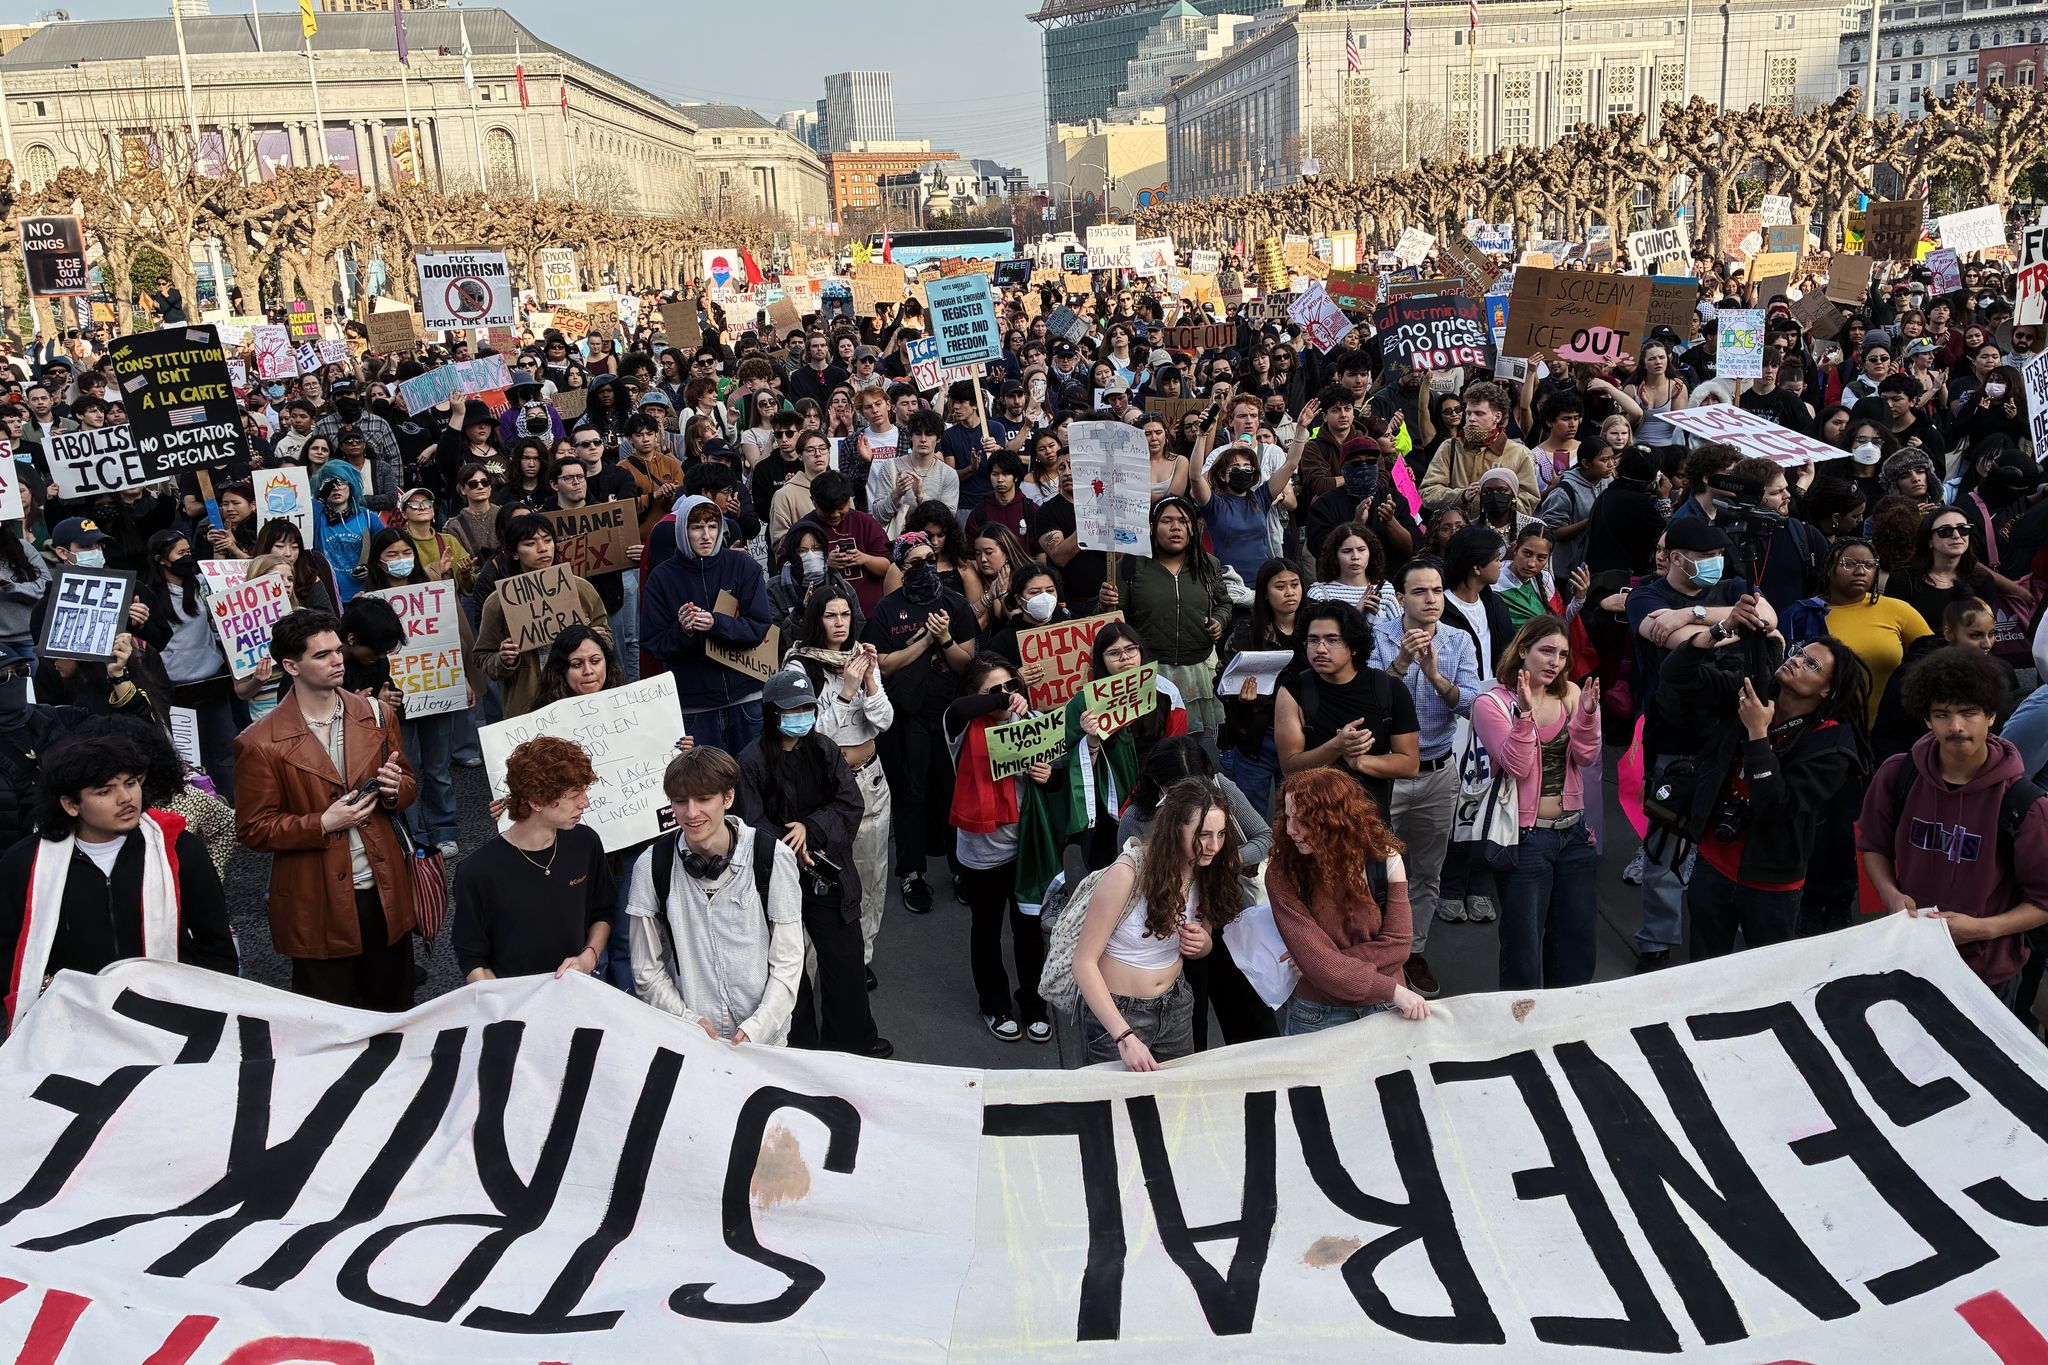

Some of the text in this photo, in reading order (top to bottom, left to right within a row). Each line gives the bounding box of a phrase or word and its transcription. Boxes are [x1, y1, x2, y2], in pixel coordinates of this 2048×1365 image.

[28, 222, 54, 237] NO
[24, 239, 65, 251] KINGS
[1475, 239, 1511, 251] DIVERSITY
[1635, 230, 1682, 257] CHINGA
[56, 258, 81, 270] ICE
[59, 268, 80, 278] OUT
[423, 263, 505, 278] DOOMERISM
[547, 263, 572, 274] NEEDS
[725, 296, 738, 304] NO
[740, 294, 754, 303] ONE
[934, 292, 987, 309] ENOUGH IS ENOUGH!
[1537, 276, 1635, 306] I SCREAM
[1651, 286, 1683, 300] eople
[293, 301, 306, 312] NO
[941, 303, 984, 322] REGISTER
[1550, 302, 1596, 318] for
[1651, 300, 1678, 310] over
[290, 312, 316, 324] SECRET
[426, 319, 457, 328] FIGHT
[461, 317, 481, 326] LIKE
[727, 321, 758, 333] STOLEN
[1379, 306, 1399, 331] all
[1403, 303, 1457, 322] vermin
[1397, 316, 1478, 338] no mice
[1649, 312, 1689, 325] rofits!
[291, 324, 318, 337] POLICE
[378, 332, 410, 342] GESTAPO
[942, 320, 989, 339] PEACE AND
[1165, 325, 1236, 350] ICE OUT
[1526, 323, 1630, 358] ICE OUT
[1719, 329, 1758, 349] ICE
[112, 344, 134, 362] THE
[907, 338, 938, 365] ICE
[946, 335, 988, 353] FREEDOM
[1399, 331, 1476, 358] no lice
[116, 348, 223, 374] CONSTITUTION
[1412, 350, 1450, 371] NO
[1451, 349, 1487, 367] ICE
[156, 368, 190, 385] ISN'T
[159, 391, 178, 406] LA
[180, 384, 229, 403] CARTE
[140, 422, 239, 454] NO DICTATOR
[1708, 429, 1841, 462] ICE
[156, 441, 236, 471] SPECIALS
[68, 450, 146, 493] ICE
[60, 578, 124, 609] ICE
[501, 566, 571, 606] CHINGA
[225, 580, 274, 616] HOT
[388, 586, 446, 619] ON'T
[221, 600, 284, 640] PEOPLE
[531, 601, 554, 620] LA
[49, 607, 120, 656] OUT
[407, 616, 440, 639] KE
[518, 608, 586, 651] MIGRA
[246, 647, 272, 670] IC
[388, 648, 461, 676] EPEAT
[1056, 649, 1093, 676] LA
[393, 667, 463, 696] YSELF
[1093, 668, 1154, 702] KEEP
[1097, 691, 1153, 732] OUT!
[1105, 691, 1138, 710] ICE
[505, 682, 676, 746] NO ONE IS ILLEGAL
[572, 711, 639, 743] STOLEN
[993, 710, 1064, 744] THANK
[616, 760, 658, 785] LACK
[621, 777, 660, 800] BLACK
